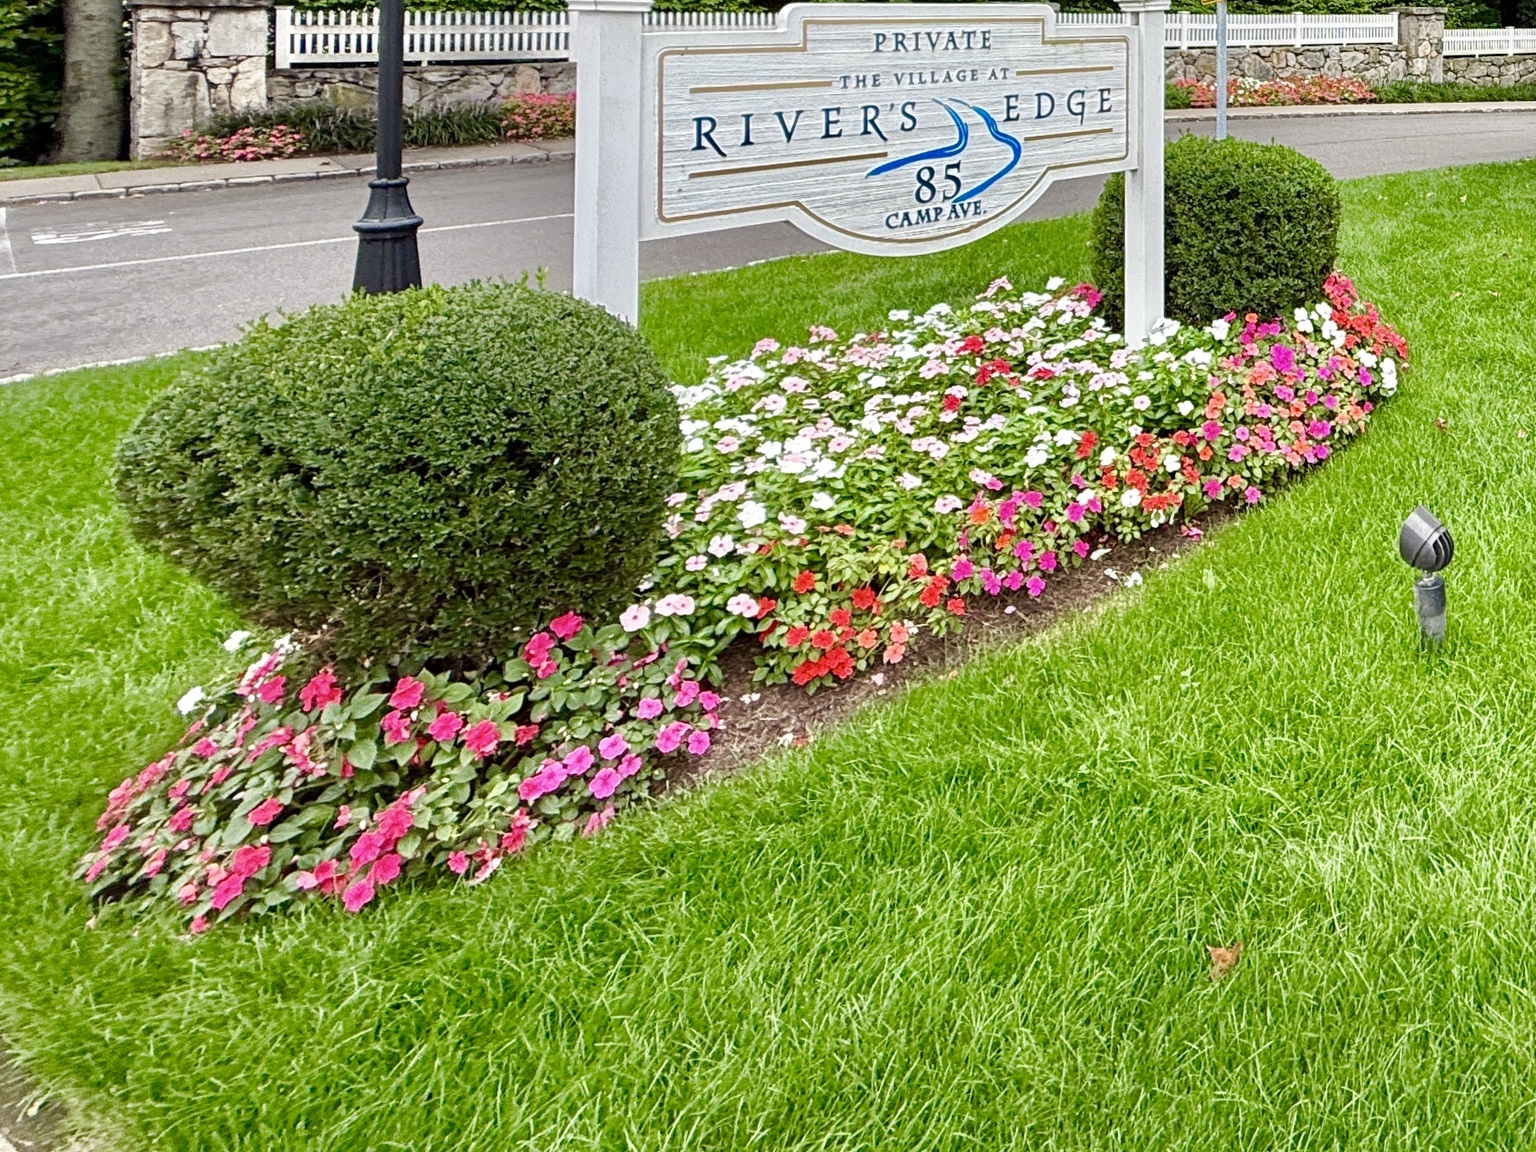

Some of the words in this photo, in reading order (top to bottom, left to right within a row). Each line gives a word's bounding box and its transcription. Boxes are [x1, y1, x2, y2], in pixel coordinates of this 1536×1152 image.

[872, 29, 992, 53] PRIVATE
[839, 73, 882, 90] THE
[893, 68, 980, 87] VILLAGE
[987, 67, 1010, 81] AT
[690, 101, 918, 158] RIVER'S
[1002, 87, 1113, 126] EDGE
[914, 160, 962, 204] 85
[885, 205, 944, 230] CAMP
[948, 199, 988, 220] AVE.
